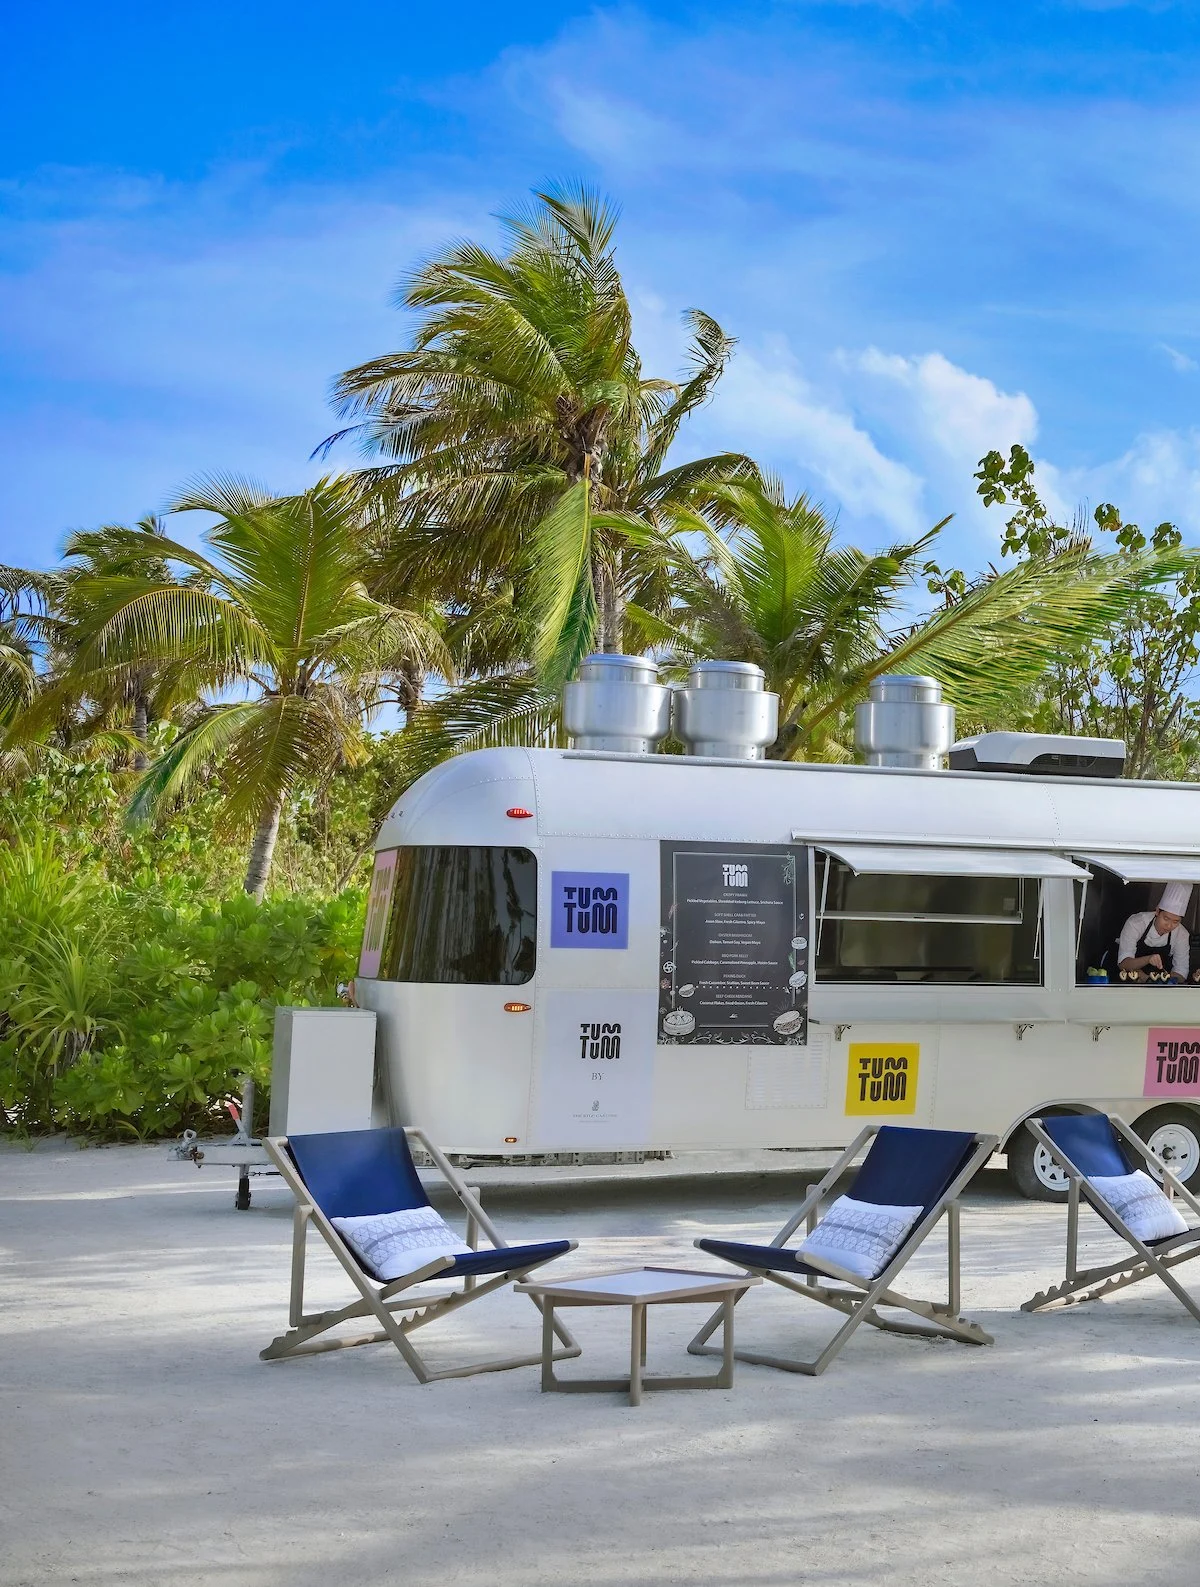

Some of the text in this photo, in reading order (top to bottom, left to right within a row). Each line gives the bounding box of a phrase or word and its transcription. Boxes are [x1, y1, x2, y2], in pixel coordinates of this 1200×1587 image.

[722, 864, 748, 876] TUM
[722, 872, 748, 887] TUM
[564, 887, 618, 906] TUM
[564, 901, 617, 934] TUM
[580, 1023, 622, 1040] TUM
[580, 1036, 620, 1059] TUM
[1157, 1041, 1200, 1062] TUM
[859, 1056, 908, 1077] TUM
[1156, 1055, 1199, 1084] TUM
[858, 1070, 907, 1102] TUM
